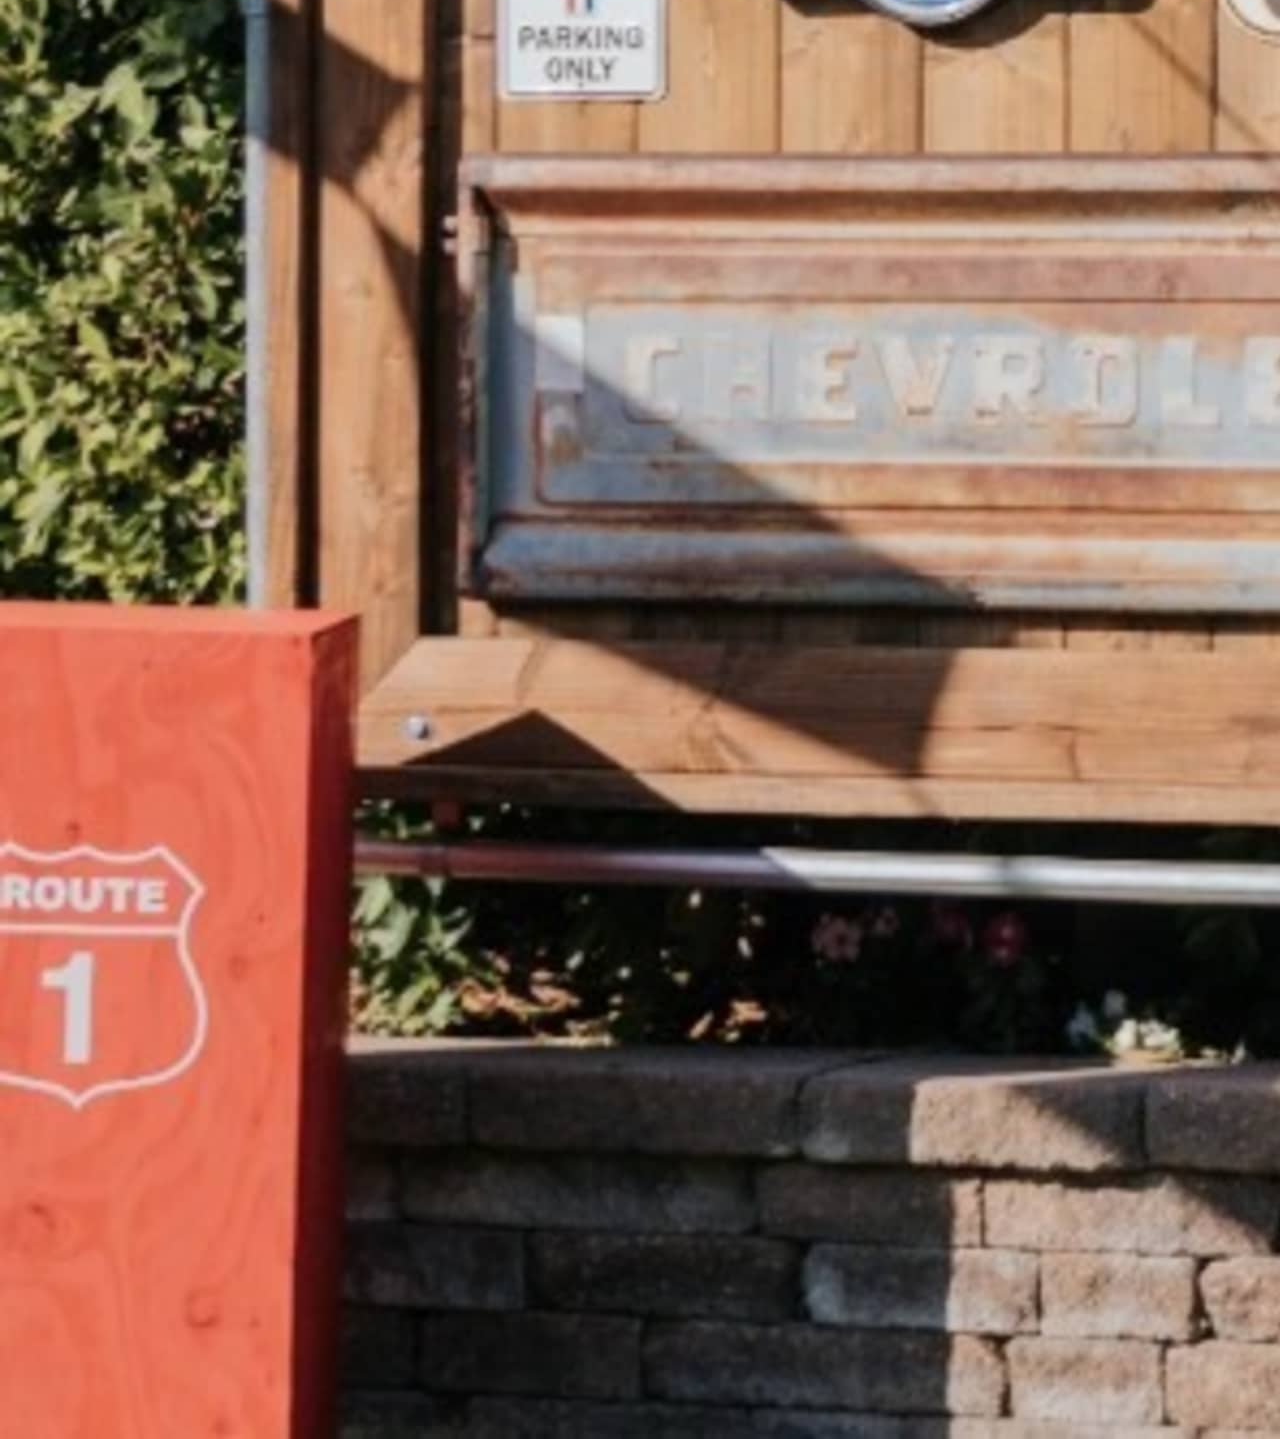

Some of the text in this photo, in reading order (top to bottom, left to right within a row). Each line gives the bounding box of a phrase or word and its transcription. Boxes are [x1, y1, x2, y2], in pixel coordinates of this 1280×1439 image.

[517, 25, 644, 50] PARKING
[543, 56, 617, 82] ONLY
[0, 873, 167, 913] ROUTE
[41, 951, 94, 1064] 1
